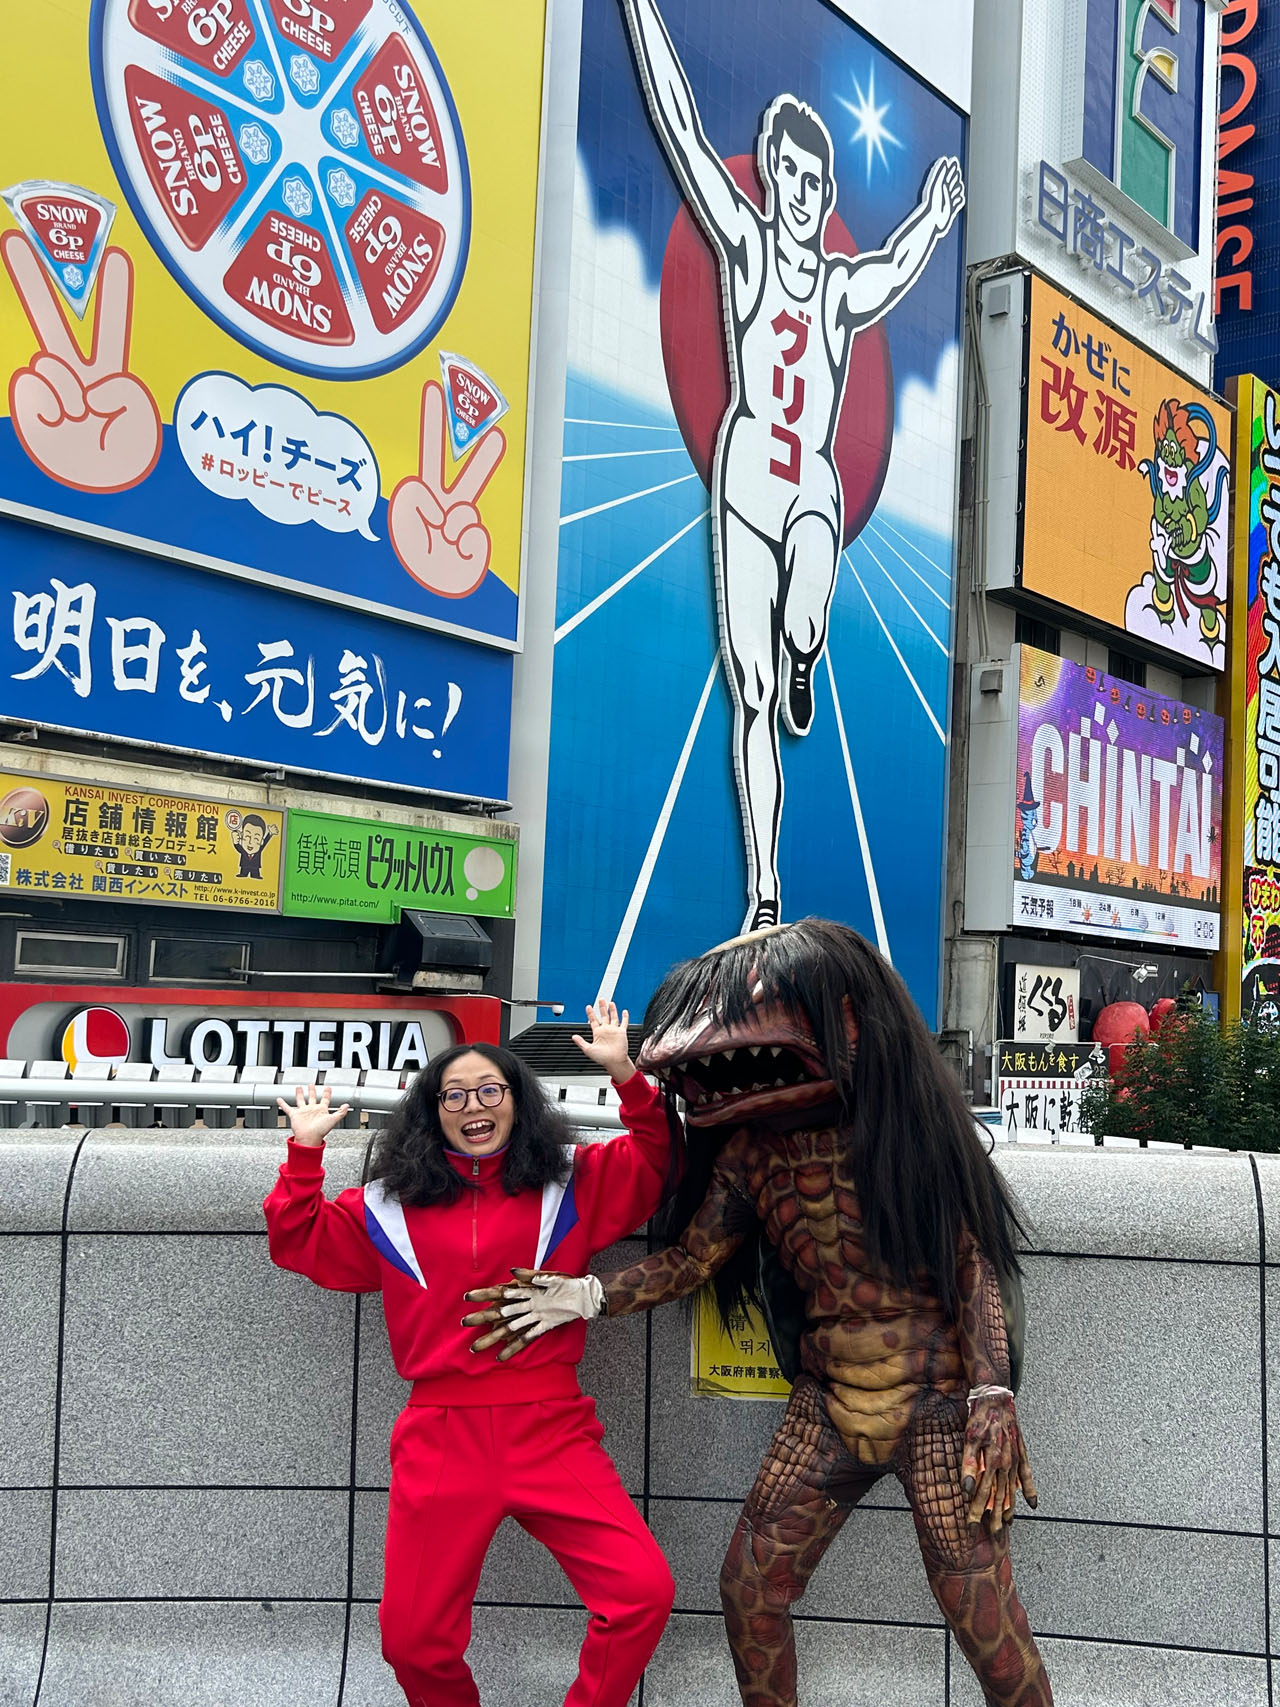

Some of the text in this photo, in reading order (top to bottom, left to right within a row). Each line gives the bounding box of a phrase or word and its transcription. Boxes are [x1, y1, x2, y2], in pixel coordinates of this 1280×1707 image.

[187, 0, 235, 46] 6P
[213, 20, 251, 70] CHEESE
[281, 16, 332, 57] CHEESE
[357, 90, 385, 155] CHEESE
[374, 84, 402, 155] 6P
[393, 65, 441, 168] SNOW
[395, 96, 413, 142] BRAND
[135, 96, 199, 216] SNOW
[173, 128, 197, 180] BRAND
[188, 114, 222, 192] 6P
[209, 113, 242, 184] CHEESE
[36, 203, 88, 225] SNOW
[53, 221, 77, 230] BRAND
[270, 216, 322, 253] CHEESE
[349, 195, 383, 243] CHEESE
[49, 228, 84, 251] 6P
[53, 249, 86, 261] CHEESE
[364, 215, 403, 264] 6P
[384, 242, 407, 276] BRAND
[266, 238, 322, 287] 6P
[381, 233, 434, 319] SNOW
[245, 276, 333, 334] SNOW
[272, 273, 311, 298] BRAND
[1051, 311, 1131, 398] かぜに
[456, 372, 491, 406] SNOW
[457, 393, 480, 418] 6P
[769, 308, 812, 487] グリコ
[455, 407, 476, 427] CHEESE
[1040, 355, 1138, 472] 改源
[190, 410, 368, 492] ハイ!チーズ
[201, 453, 352, 517] #ロッピーでピース
[10, 578, 463, 760] 明日を、元気に!
[64, 785, 219, 816] KANSAI INVEST CORPORATION
[1031, 715, 1214, 879] CHINTAI
[61, 826, 218, 856] 居抜き店舗総合プロデュース
[62, 798, 219, 843] 店舗情報館
[229, 814, 239, 826] 店
[65, 842, 119, 859] 借りたい
[106, 862, 159, 877] 貸したい
[134, 850, 187, 866] 買いたい
[365, 834, 456, 897] ピタットハウス
[16, 868, 189, 899] 株式会社 関西インベスト
[174, 869, 223, 884] 売りたい
[194, 884, 276, 899] http://www.k-invest.co.jp
[194, 893, 275, 908] TEL 06-6766-2016
[291, 892, 380, 909] http://www.pitat.com/
[1020, 895, 1055, 919] 天気予報
[1027, 974, 1068, 1033] くくる
[146, 1017, 429, 1072] LOTTERIA
[1001, 1050, 1079, 1074] 大阪もんを食す
[708, 1364, 784, 1380] 大阪府南警察
